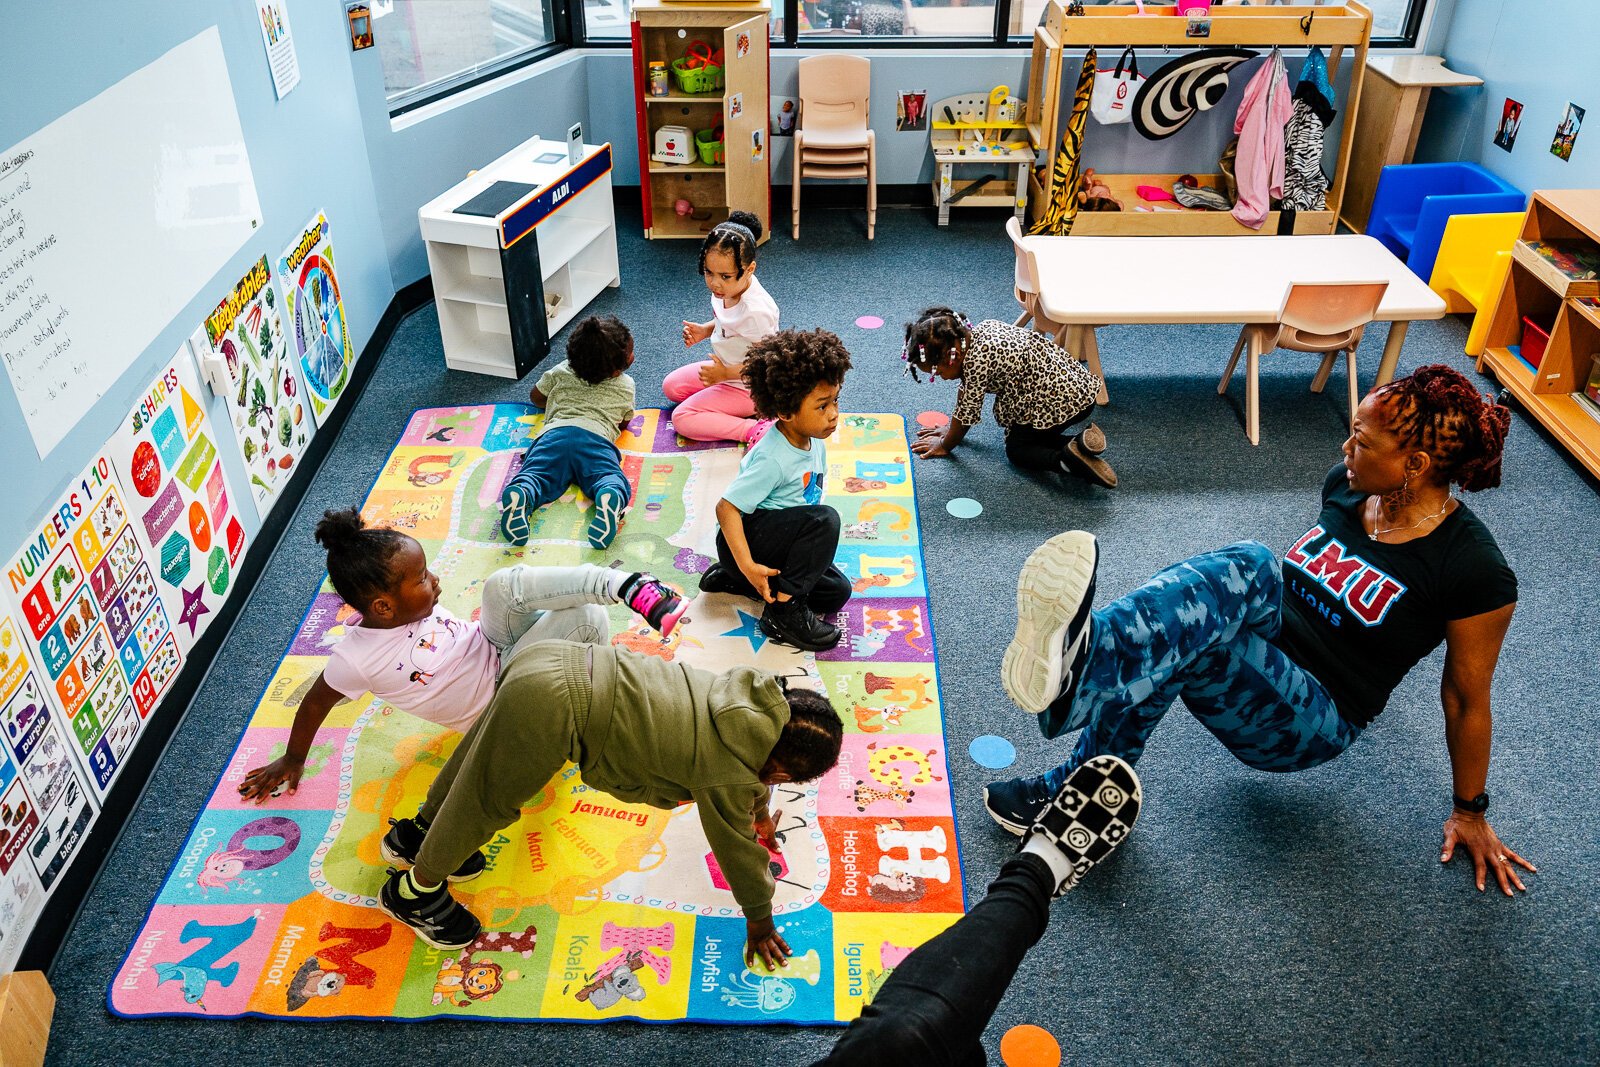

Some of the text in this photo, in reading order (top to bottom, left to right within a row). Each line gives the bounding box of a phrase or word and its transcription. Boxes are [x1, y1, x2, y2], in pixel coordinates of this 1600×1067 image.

[552, 181, 570, 205] ALDI
[286, 222, 322, 273] weather
[209, 263, 268, 337] Vegetables
[140, 368, 178, 423] SHAPES
[306, 370, 323, 395] cloudy
[161, 426, 178, 452] square
[139, 459, 155, 480] circle
[643, 464, 674, 523] Rainbow
[8, 457, 109, 594] NUMBERS 1-10
[152, 496, 178, 530] rectangle
[195, 517, 206, 535] oval
[81, 530, 93, 551] 6
[88, 551, 99, 564] six
[163, 544, 188, 575] hexagon
[211, 557, 226, 584] octagon
[684, 553, 697, 573] Grape
[96, 567, 106, 592] 7
[1283, 524, 1408, 627] LMU
[30, 594, 44, 616] 1
[101, 584, 118, 609] seven
[186, 598, 199, 617] star
[1292, 579, 1342, 627] LIONS
[37, 612, 51, 632] one
[112, 606, 122, 627] 8
[301, 608, 327, 639] Rabbit
[836, 611, 849, 648] Elephant
[116, 620, 130, 643] eight
[47, 634, 61, 659] 2
[125, 646, 136, 662] 9
[52, 652, 67, 672] two
[129, 660, 142, 679] nine
[0, 663, 23, 701] yellow
[64, 675, 76, 697] 3
[135, 675, 151, 700] 10
[269, 677, 292, 702] Quail
[835, 674, 852, 694] Fox
[67, 688, 87, 715] three
[142, 695, 154, 711] ten
[78, 708, 93, 730] 4
[22, 715, 46, 754] purple
[84, 727, 99, 750] four
[95, 747, 108, 770] 5
[227, 747, 258, 782] Panda
[838, 751, 853, 791] Giraffe
[868, 744, 932, 787] G
[49, 769, 65, 798] gray
[100, 764, 114, 784] five
[570, 800, 649, 826] January
[5, 822, 33, 864] brown
[59, 831, 80, 860] black
[179, 827, 217, 878] Octopus
[227, 816, 301, 871] O
[484, 834, 511, 872] April
[526, 831, 548, 873] March
[550, 817, 609, 870] February
[877, 826, 951, 884] H
[841, 830, 859, 897] Hedgehog
[121, 930, 167, 991] Narwhal
[179, 915, 258, 987] N
[263, 925, 305, 987] Marmot
[314, 921, 393, 989] M
[423, 945, 441, 966] on
[563, 935, 589, 981] Koala
[596, 921, 675, 986] K
[701, 935, 722, 993] Jellyfish
[849, 942, 865, 997] Iguana
